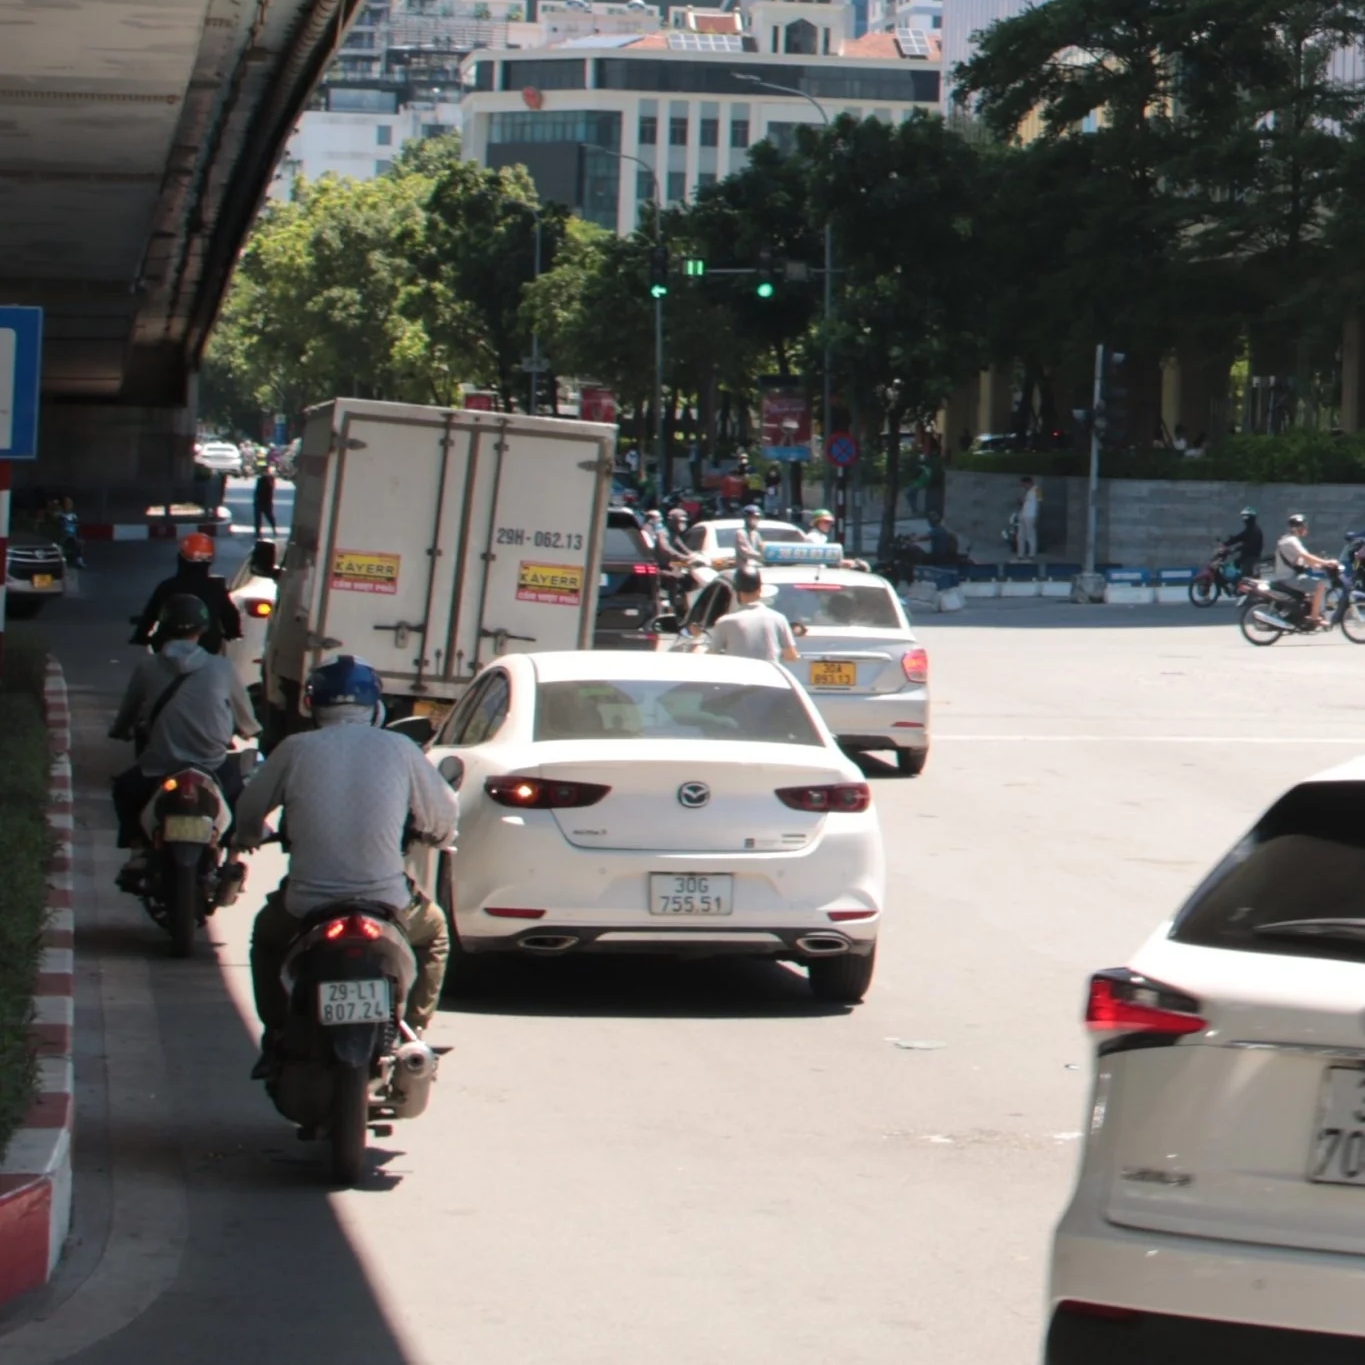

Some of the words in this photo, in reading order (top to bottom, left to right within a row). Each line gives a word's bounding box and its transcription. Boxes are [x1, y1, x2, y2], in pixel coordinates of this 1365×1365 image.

[675, 877, 709, 893] 30G
[660, 896, 722, 912] 755.51
[329, 982, 376, 1002] 29-L1
[324, 1001, 384, 1021] 807.24
